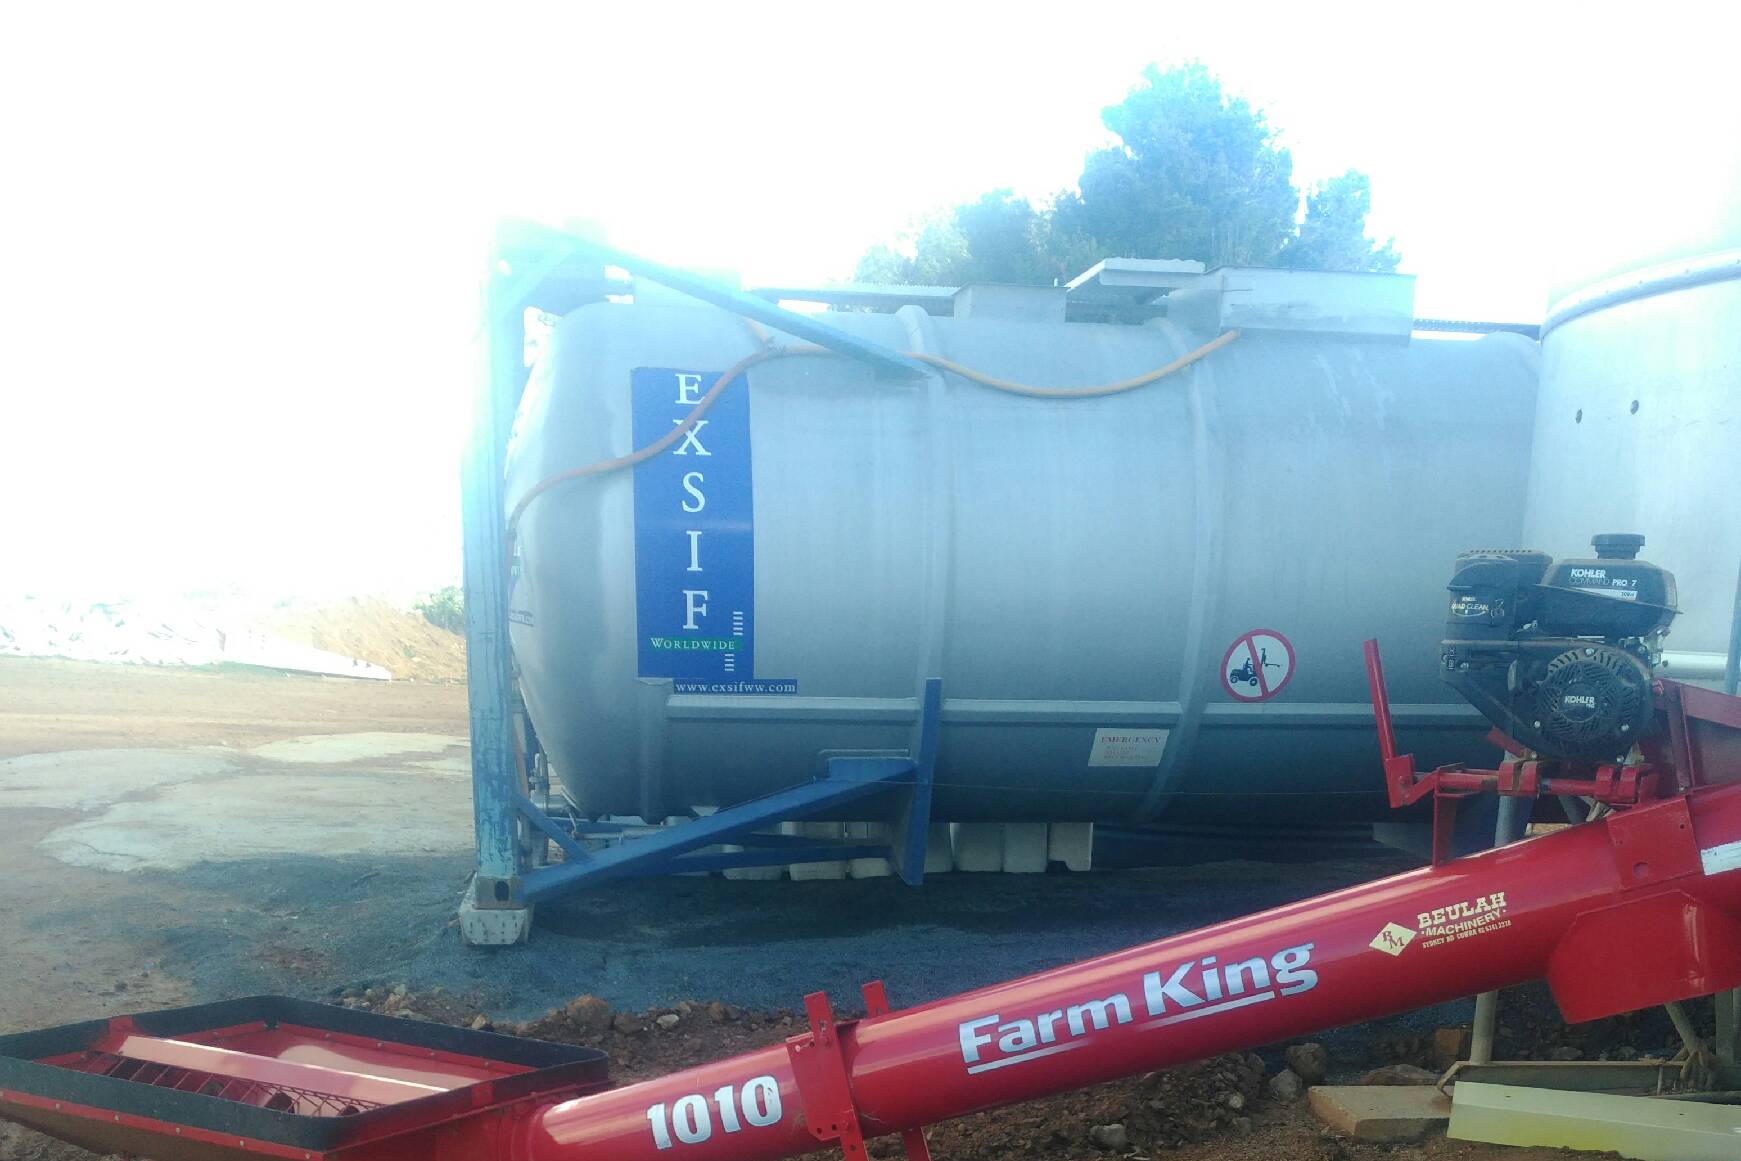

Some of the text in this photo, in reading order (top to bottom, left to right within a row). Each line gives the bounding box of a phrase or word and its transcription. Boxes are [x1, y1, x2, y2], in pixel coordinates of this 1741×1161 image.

[673, 373, 712, 630] EXSIF
[1571, 569, 1606, 578] KOHLER
[1631, 579, 1638, 587] 7
[675, 681, 796, 694] www.exsifww.com
[1564, 696, 1595, 704] KOHLER
[1417, 892, 1506, 928] BEULAH
[957, 942, 1318, 1067] Farm King
[647, 1075, 781, 1150] 1010
